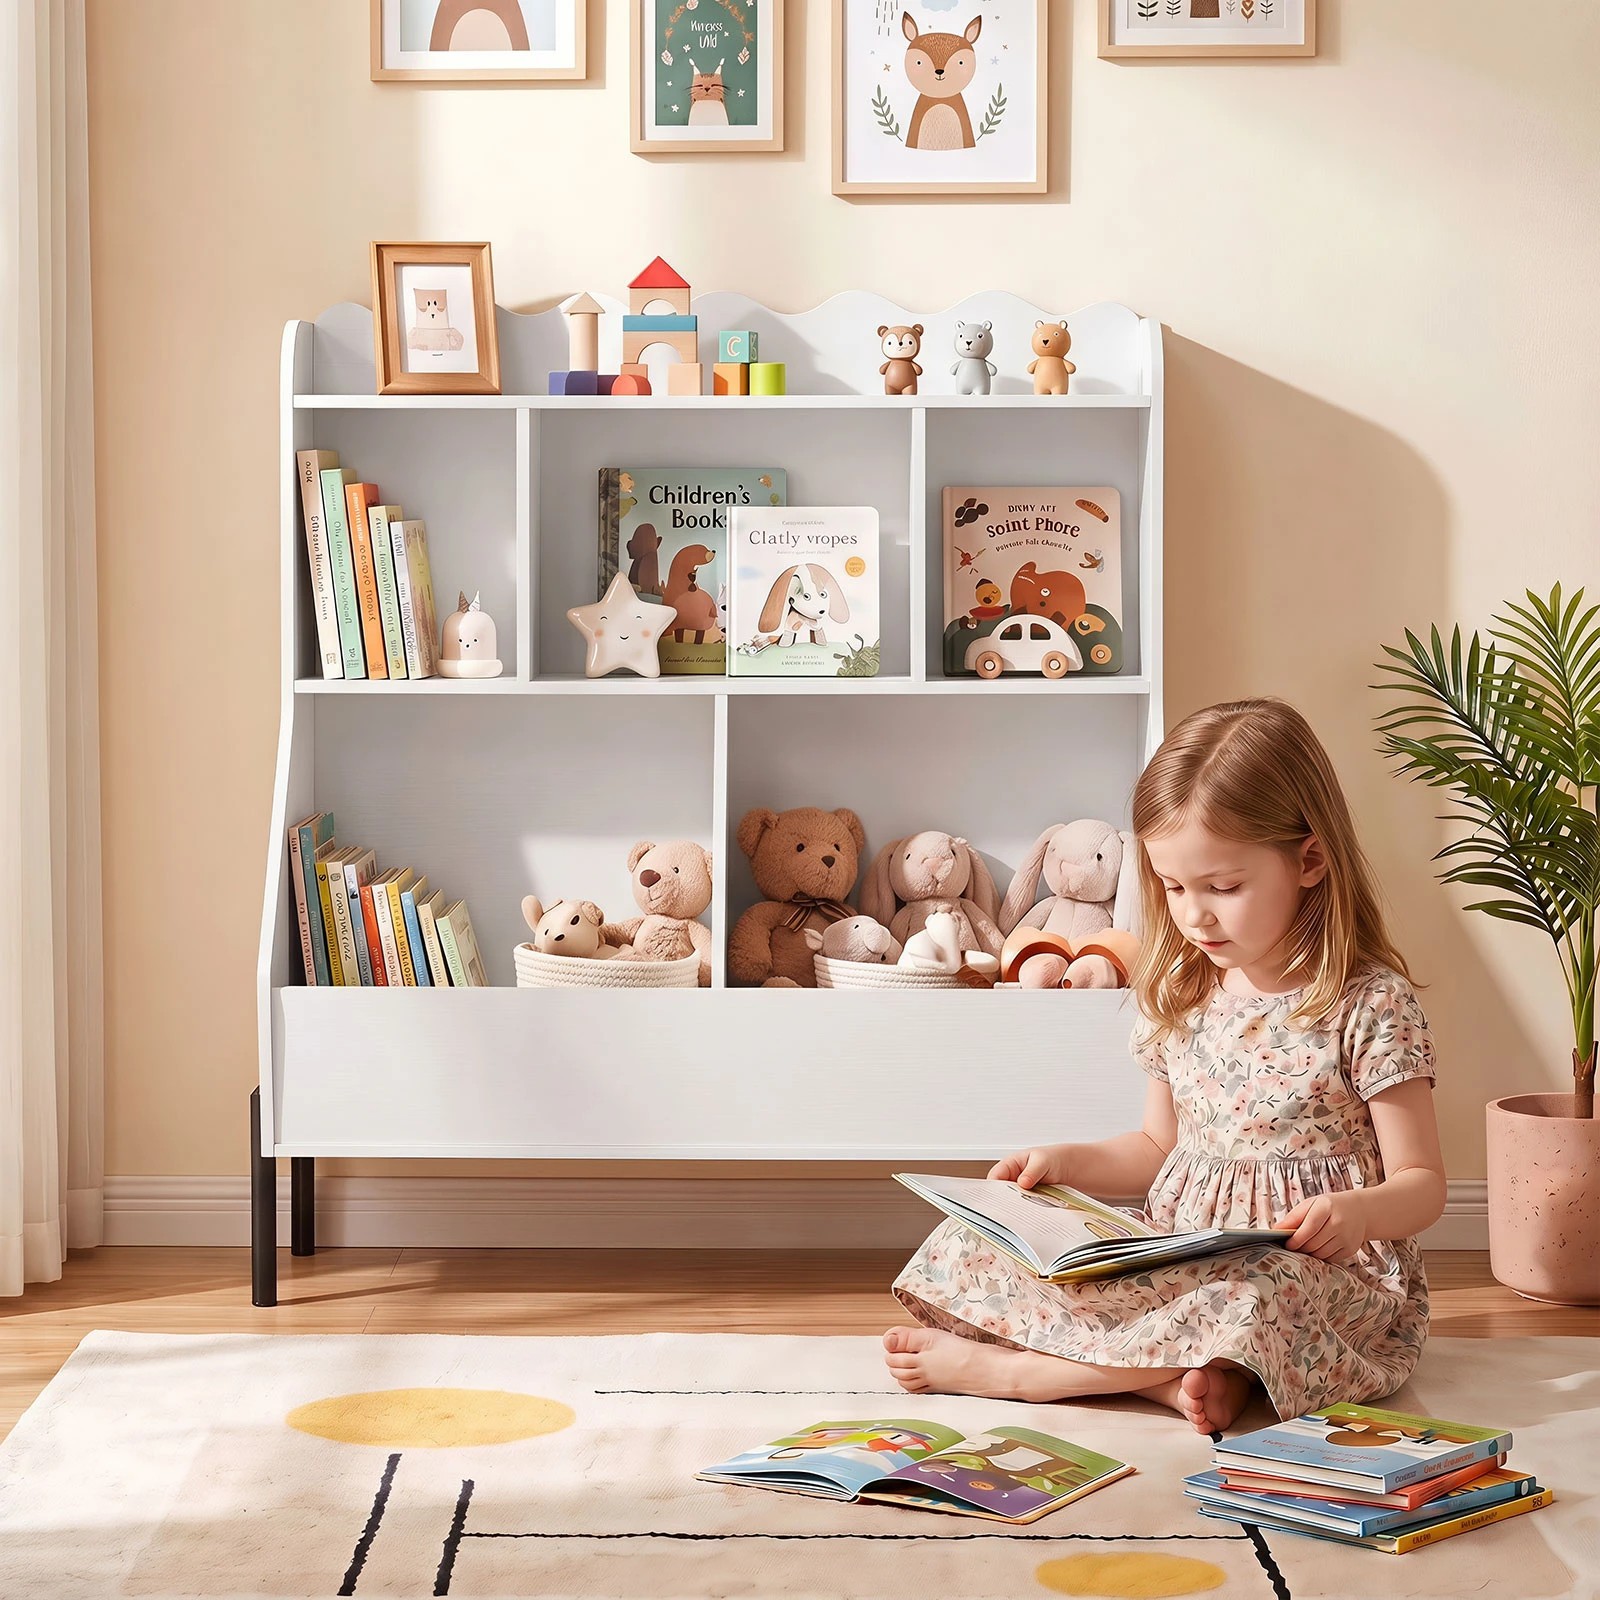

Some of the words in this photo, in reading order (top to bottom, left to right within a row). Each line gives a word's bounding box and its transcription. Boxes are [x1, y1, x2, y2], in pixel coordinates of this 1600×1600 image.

[728, 336, 742, 357] C
[649, 484, 751, 505] Children's
[672, 508, 727, 528] Book
[986, 518, 1031, 538] Soint
[1035, 517, 1081, 538] Phore
[749, 530, 801, 548] Clatly
[807, 534, 858, 548] vropes
